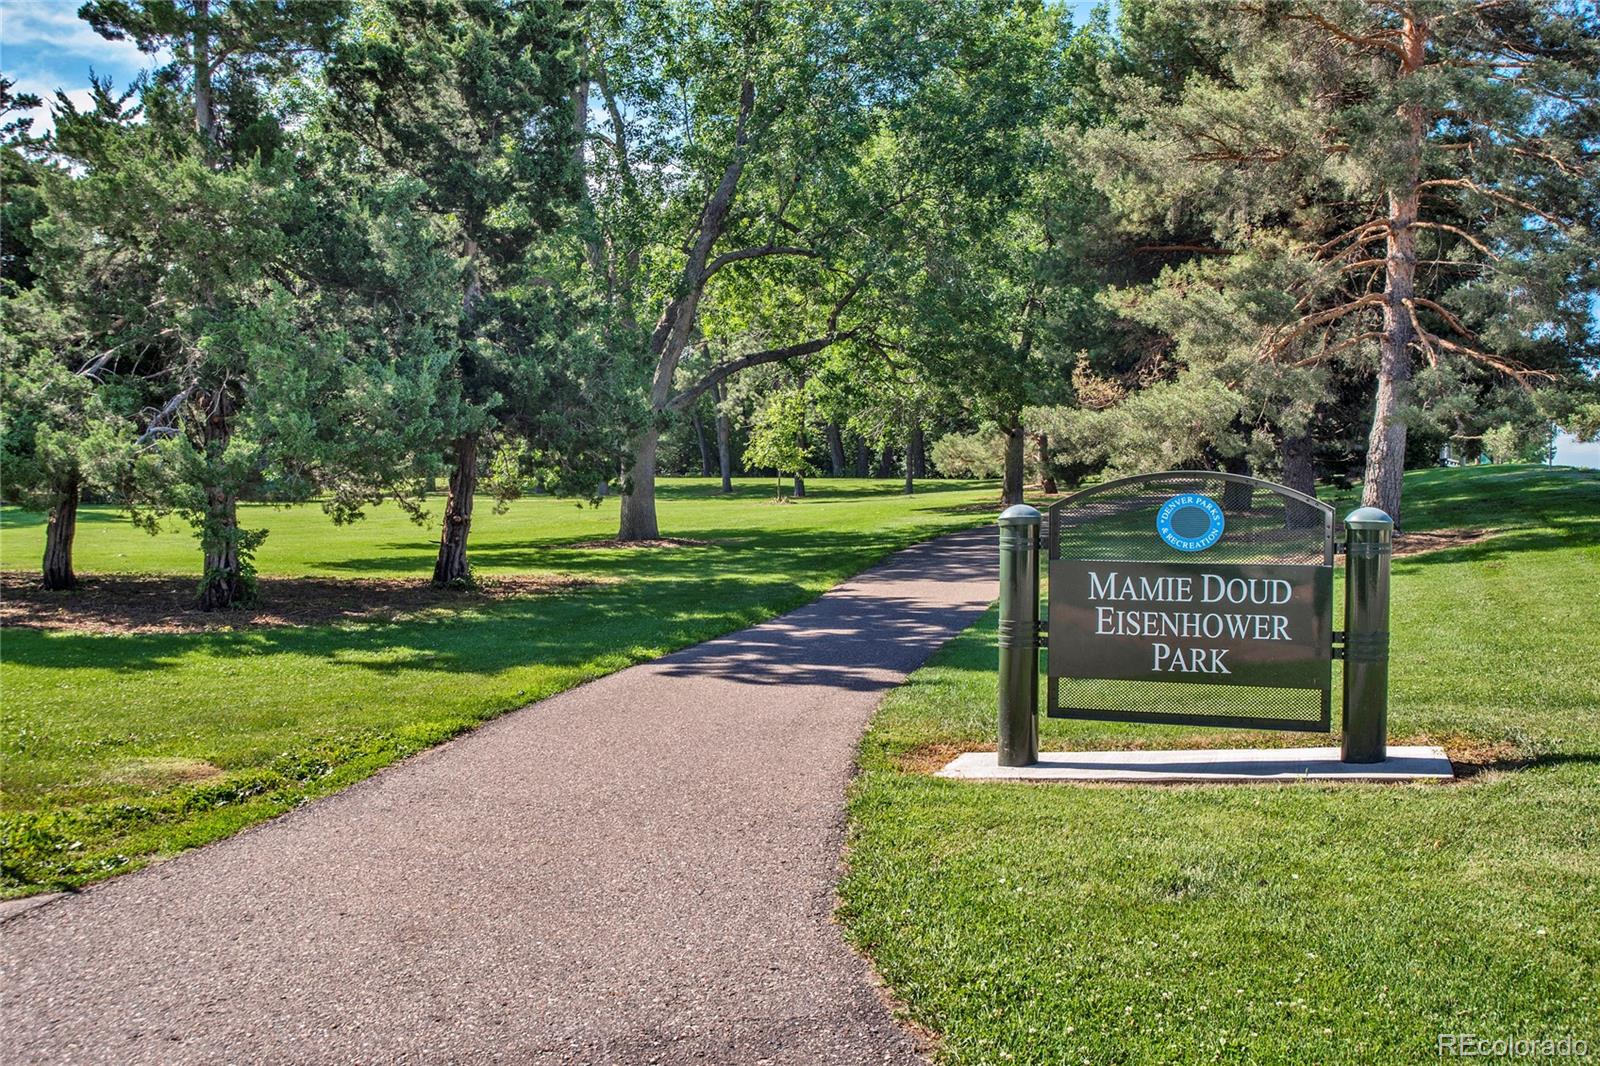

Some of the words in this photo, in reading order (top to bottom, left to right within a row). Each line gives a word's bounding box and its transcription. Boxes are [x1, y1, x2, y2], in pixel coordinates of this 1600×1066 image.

[1162, 496, 1194, 520] DENVER
[1195, 497, 1221, 521] PARKS
[1161, 527, 1169, 535] &
[1166, 528, 1219, 549] RECREATION
[1087, 571, 1193, 602] MAMIE
[1201, 574, 1293, 605] DOUD
[1095, 606, 1293, 641] EISENHOWER
[1151, 642, 1232, 674] PARK
